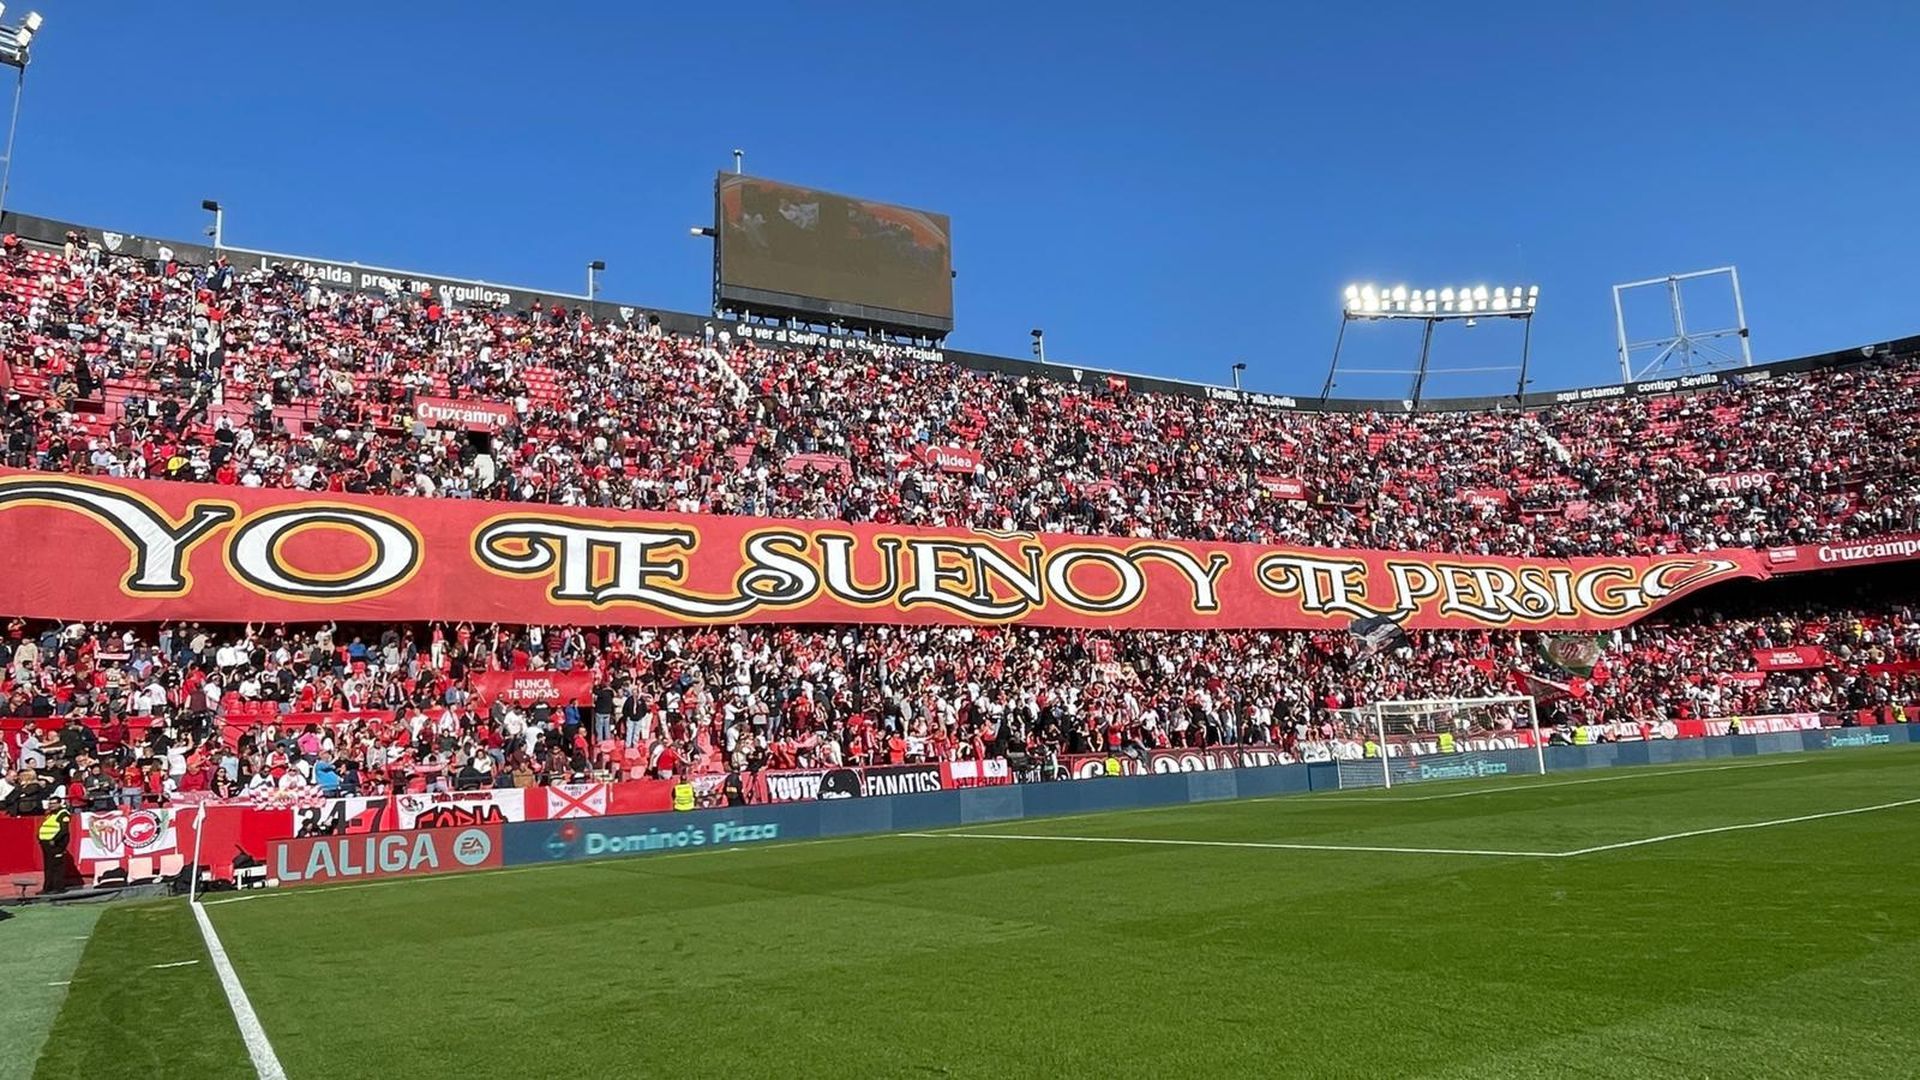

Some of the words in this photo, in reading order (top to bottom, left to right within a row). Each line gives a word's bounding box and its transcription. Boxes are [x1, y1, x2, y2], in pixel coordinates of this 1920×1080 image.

[736, 324, 751, 337] de
[755, 328, 774, 341] ver
[776, 330, 788, 342] al
[829, 338, 843, 349] en
[1204, 387, 1211, 397] Y
[1580, 386, 1626, 399] estamos
[1637, 380, 1678, 393] contigo
[1680, 373, 1719, 387] Sevilla
[417, 402, 508, 426] Cruzcampo
[0, 480, 420, 598] YO
[475, 516, 757, 617] TE
[739, 526, 1144, 618] SUEÑO
[1128, 546, 1228, 612] Y
[1258, 553, 1408, 620] TE
[1818, 539, 1920, 562] Cruzcamp
[507, 689, 520, 699] TE
[515, 679, 551, 689] NUNCA
[1420, 760, 1476, 779] Domino's
[1477, 760, 1507, 777] Pizza
[867, 771, 941, 797] FANATICS
[586, 825, 705, 854] Domino's
[712, 821, 779, 844] Pizza
[278, 833, 439, 881] LALIGA
[461, 837, 484, 850] EA
